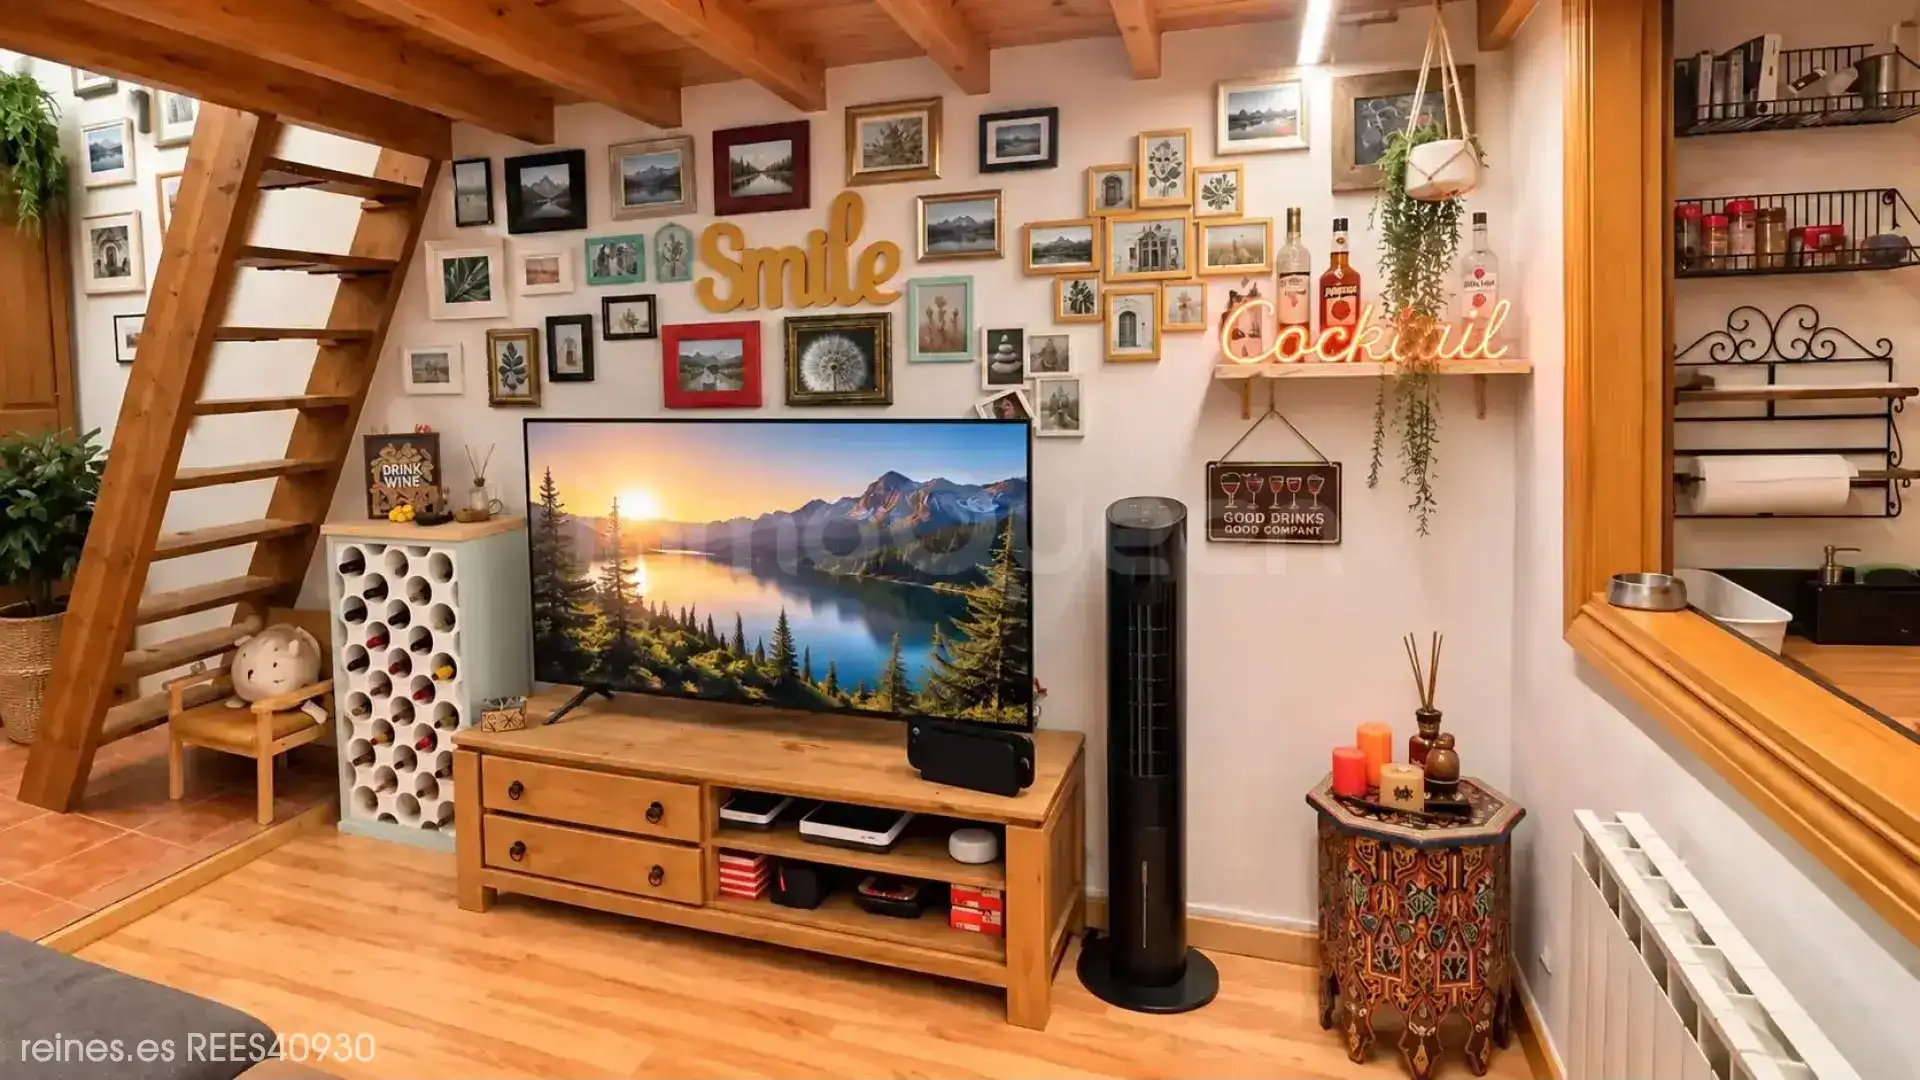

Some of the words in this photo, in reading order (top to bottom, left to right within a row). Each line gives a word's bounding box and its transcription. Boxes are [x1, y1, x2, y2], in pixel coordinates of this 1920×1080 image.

[696, 190, 903, 313] Smile
[1222, 299, 1512, 364] Cockail
[382, 462, 423, 476] DRINK
[383, 475, 421, 488] WINE
[1223, 511, 1265, 523] GOOD
[1271, 512, 1325, 525] DRINKS
[1224, 524, 1260, 535] GOOD
